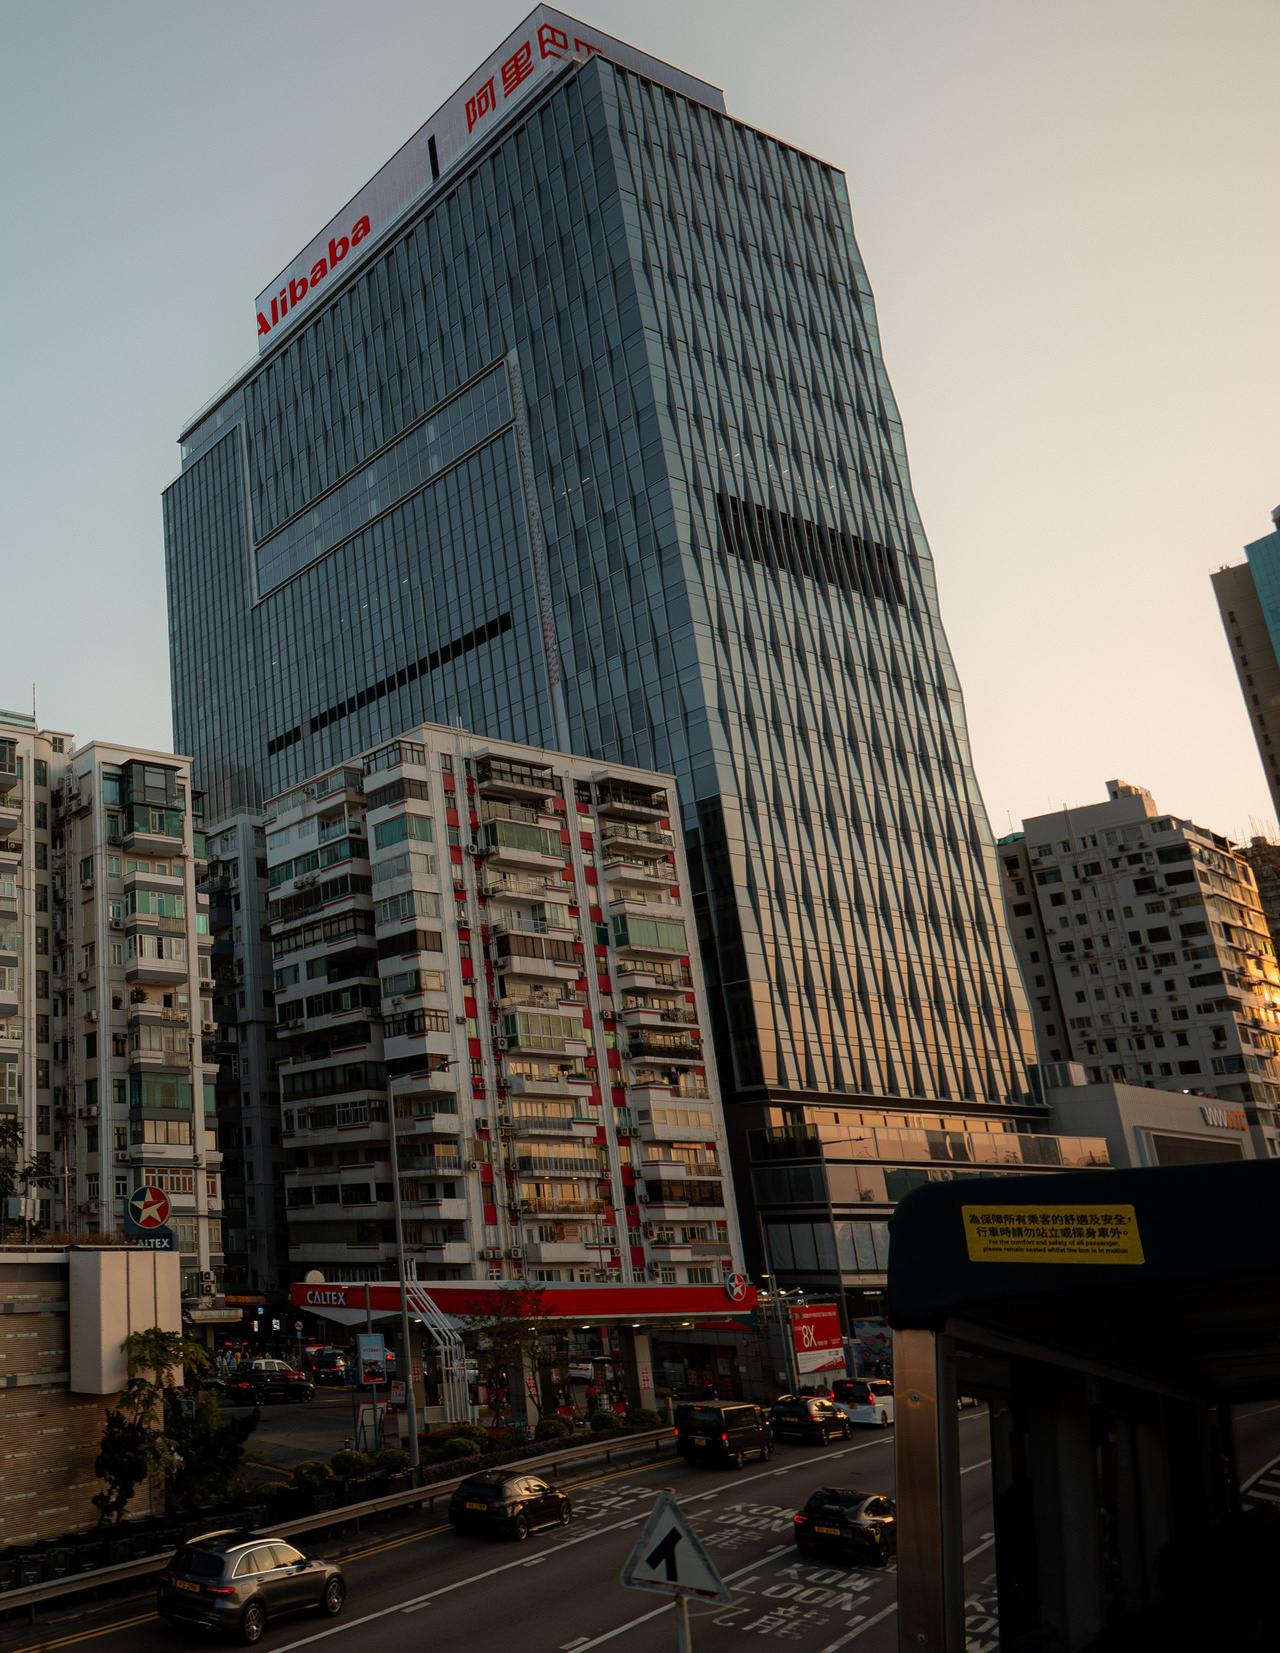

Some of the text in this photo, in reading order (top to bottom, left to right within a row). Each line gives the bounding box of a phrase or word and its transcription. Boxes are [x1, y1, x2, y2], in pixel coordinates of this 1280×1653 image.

[257, 215, 371, 336] Alibaba
[137, 1238, 170, 1248] ALTEX
[306, 1291, 346, 1305] CALTEX
[801, 1325, 818, 1348] 8X
[773, 1563, 882, 1592] KOW
[729, 1576, 871, 1611] LOON
